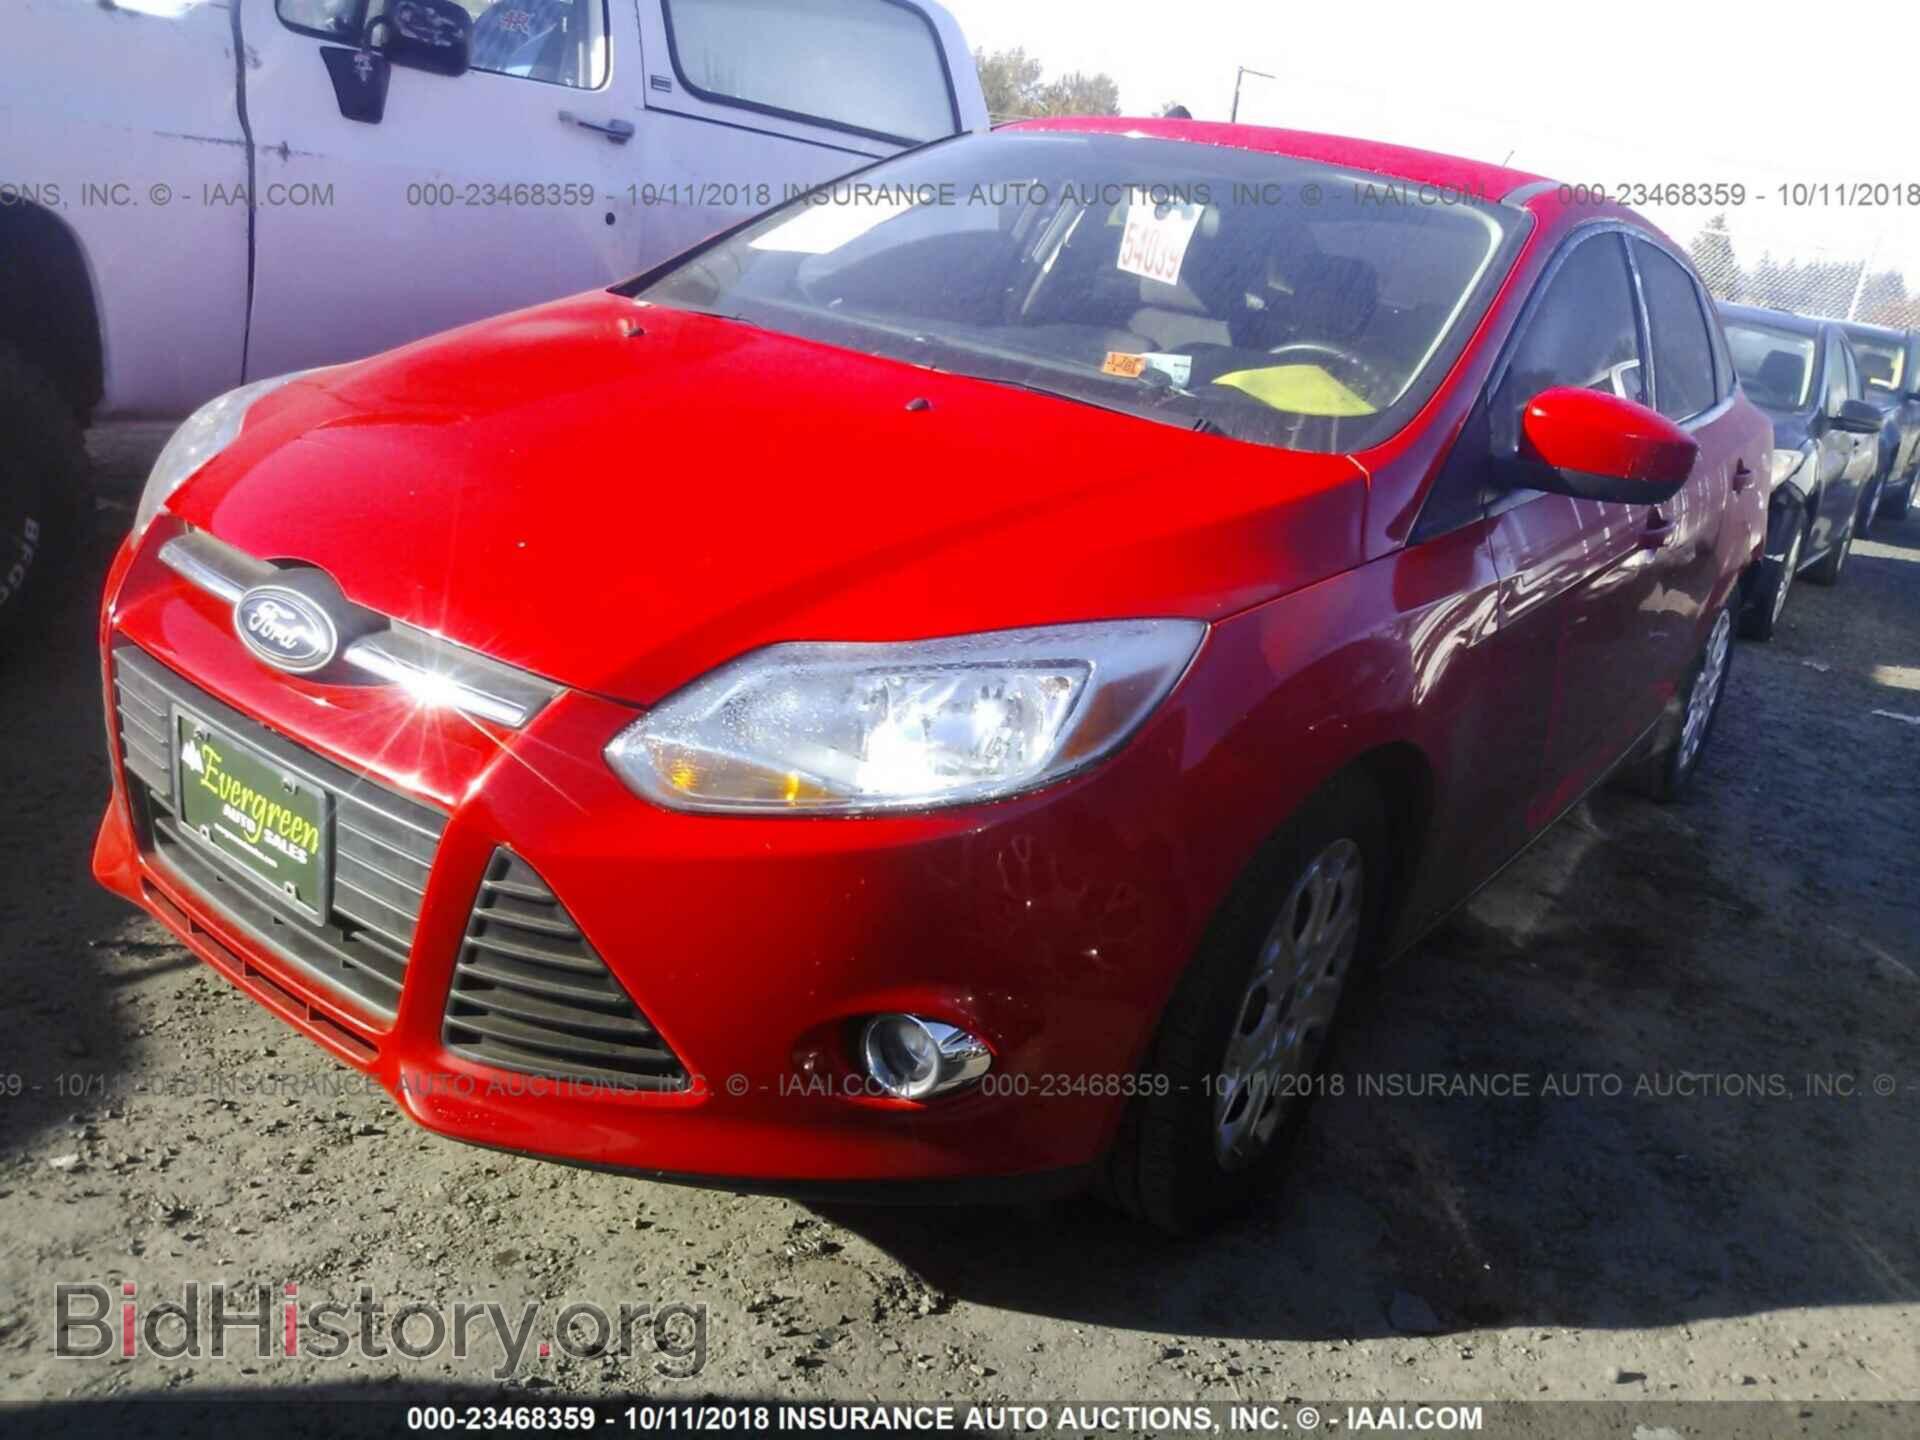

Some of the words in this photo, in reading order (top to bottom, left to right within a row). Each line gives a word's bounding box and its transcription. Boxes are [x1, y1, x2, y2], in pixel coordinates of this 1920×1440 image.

[247, 599, 312, 650] Ford
[200, 743, 319, 855] Evergreen
[263, 828, 308, 865] SALES
